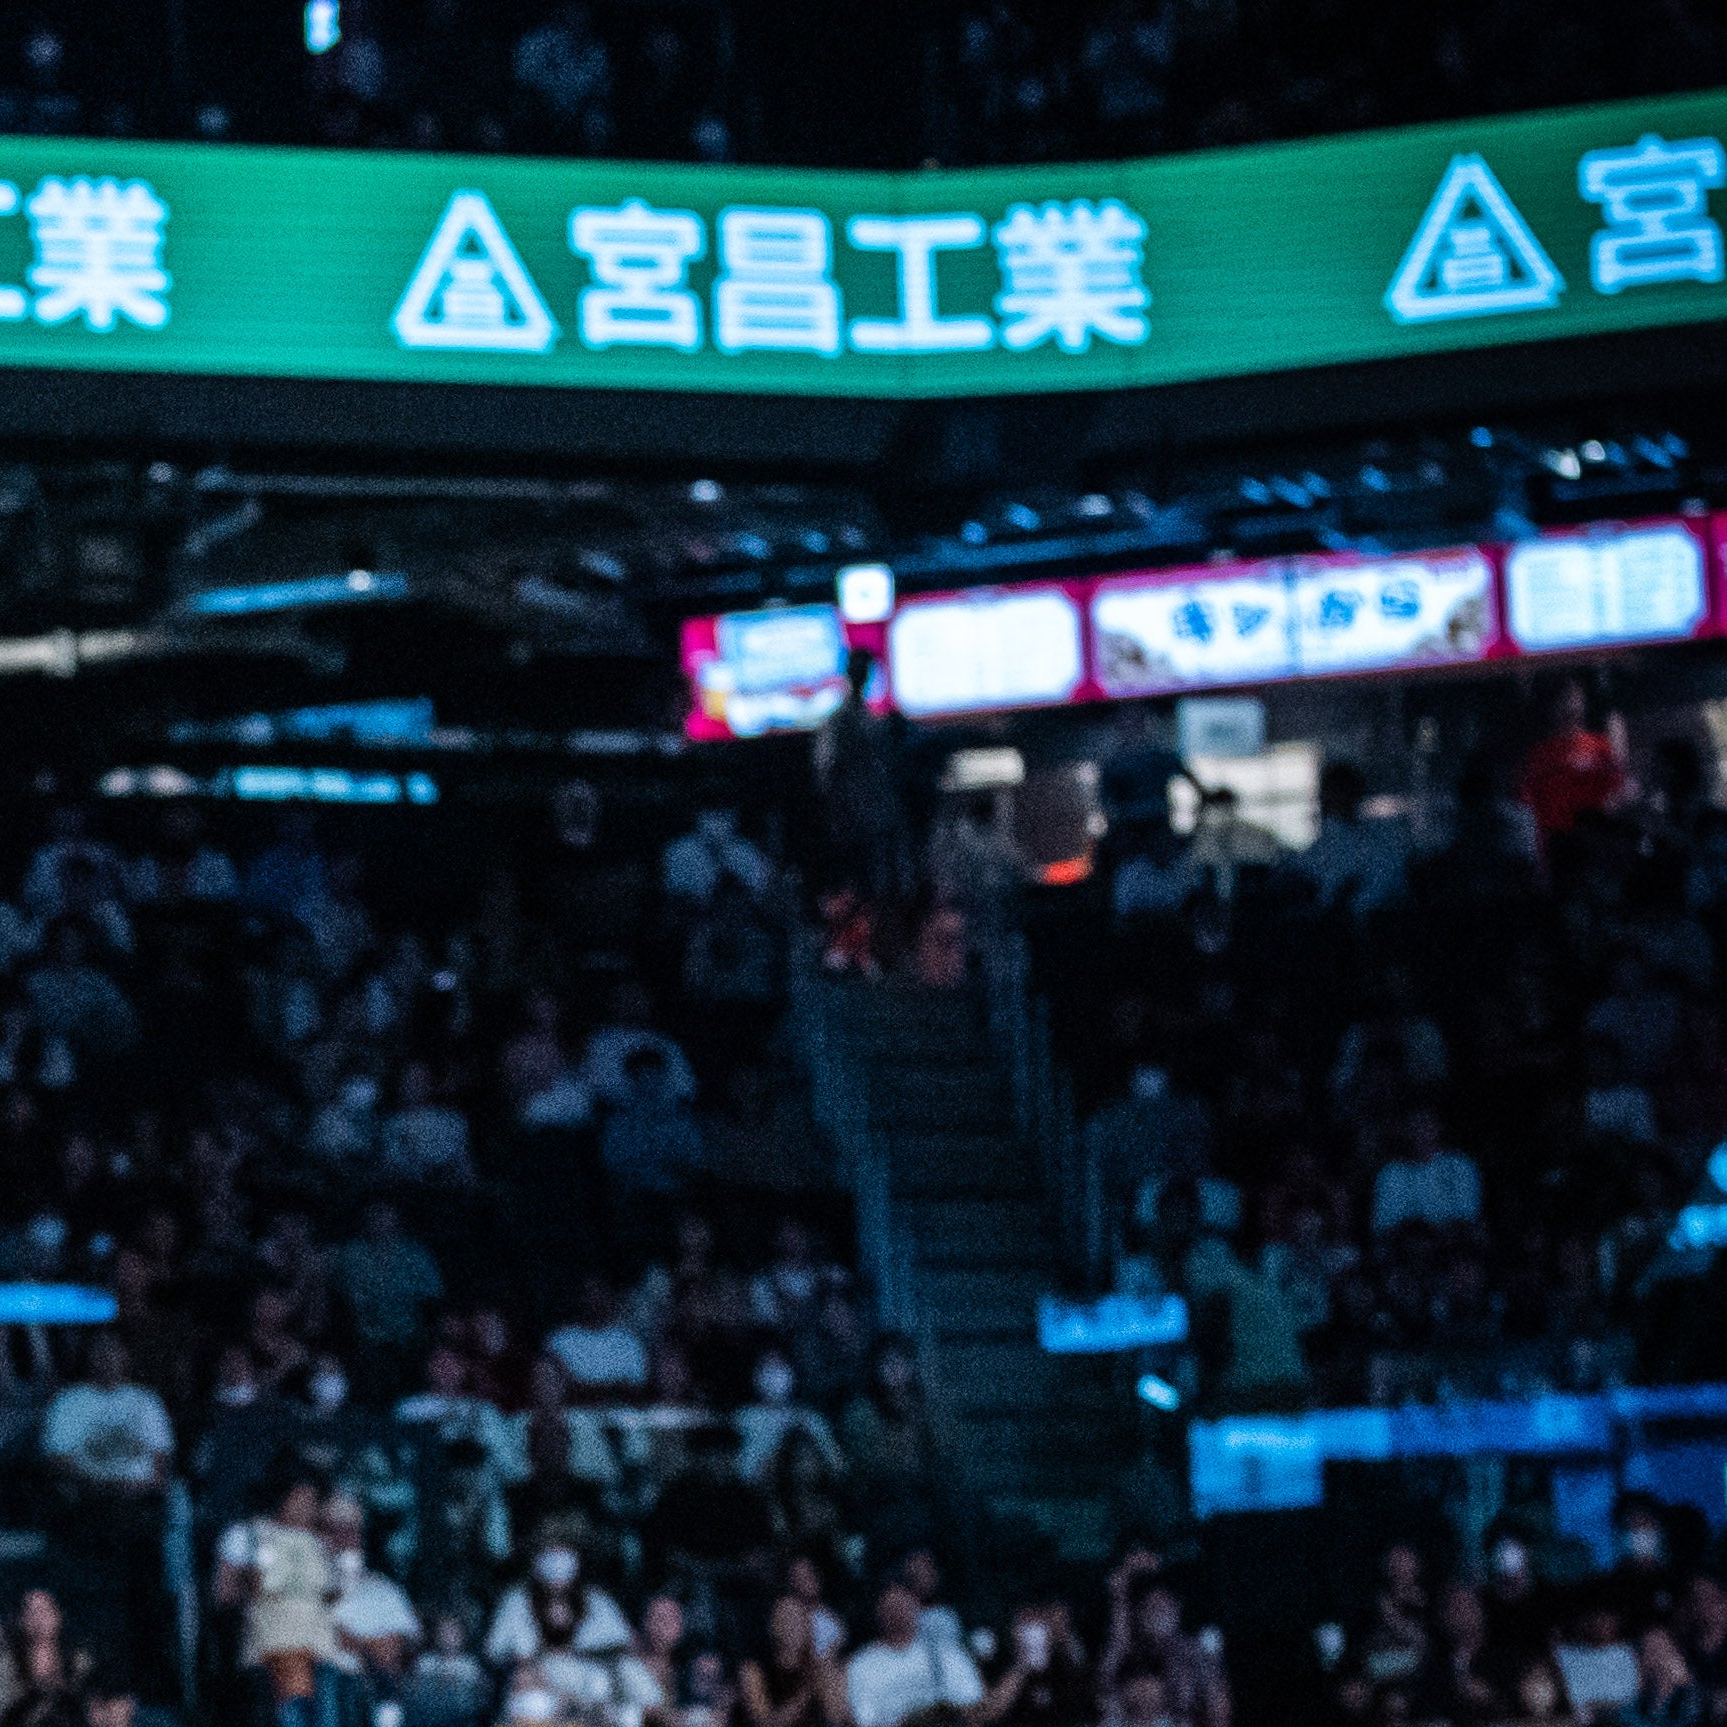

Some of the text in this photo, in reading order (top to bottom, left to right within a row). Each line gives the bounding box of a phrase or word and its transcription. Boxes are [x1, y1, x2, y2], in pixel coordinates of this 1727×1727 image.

[568, 197, 1149, 357] 宮昌工業
[1577, 134, 1727, 295] 宮
